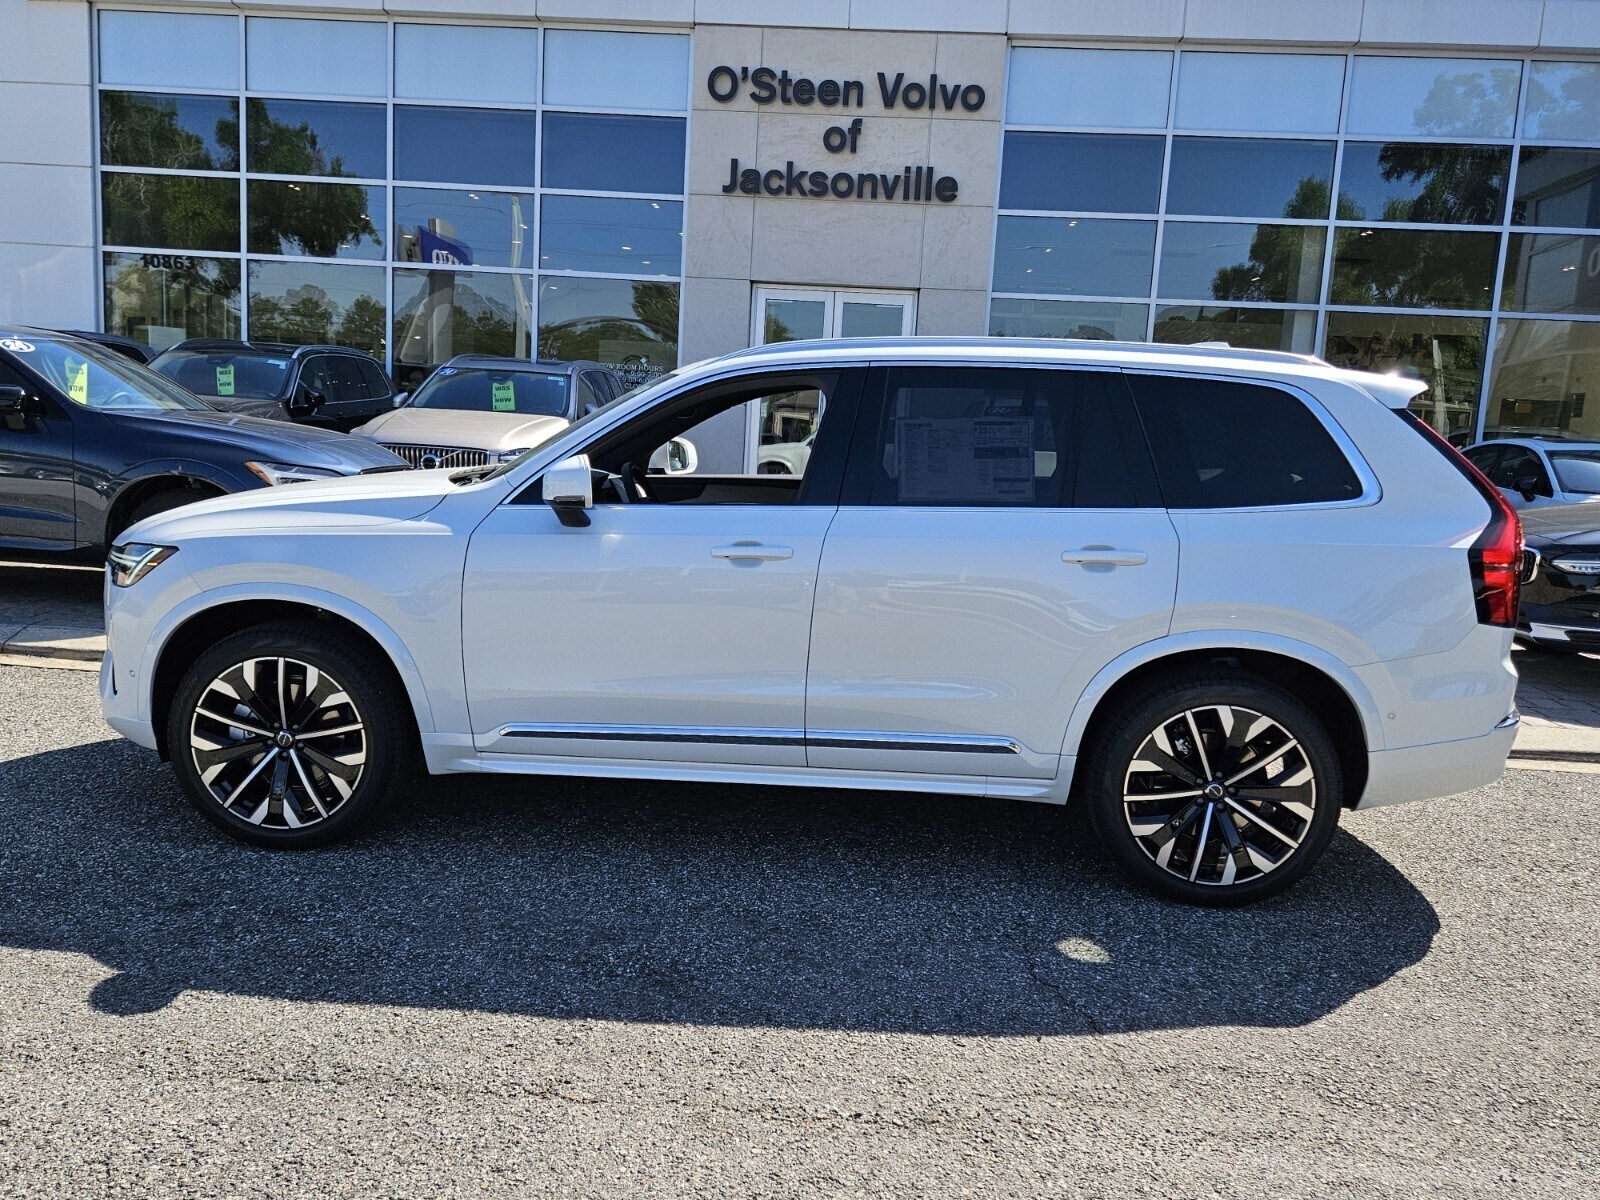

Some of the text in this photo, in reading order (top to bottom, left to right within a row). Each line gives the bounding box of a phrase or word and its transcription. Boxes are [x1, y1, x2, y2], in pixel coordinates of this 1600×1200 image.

[707, 65, 986, 111] O'Steen Volvo
[823, 118, 863, 153] of
[721, 158, 959, 202] Jacksonville
[140, 253, 195, 270] 10863
[616, 363, 637, 371] ROOM
[638, 364, 664, 372] HOURS
